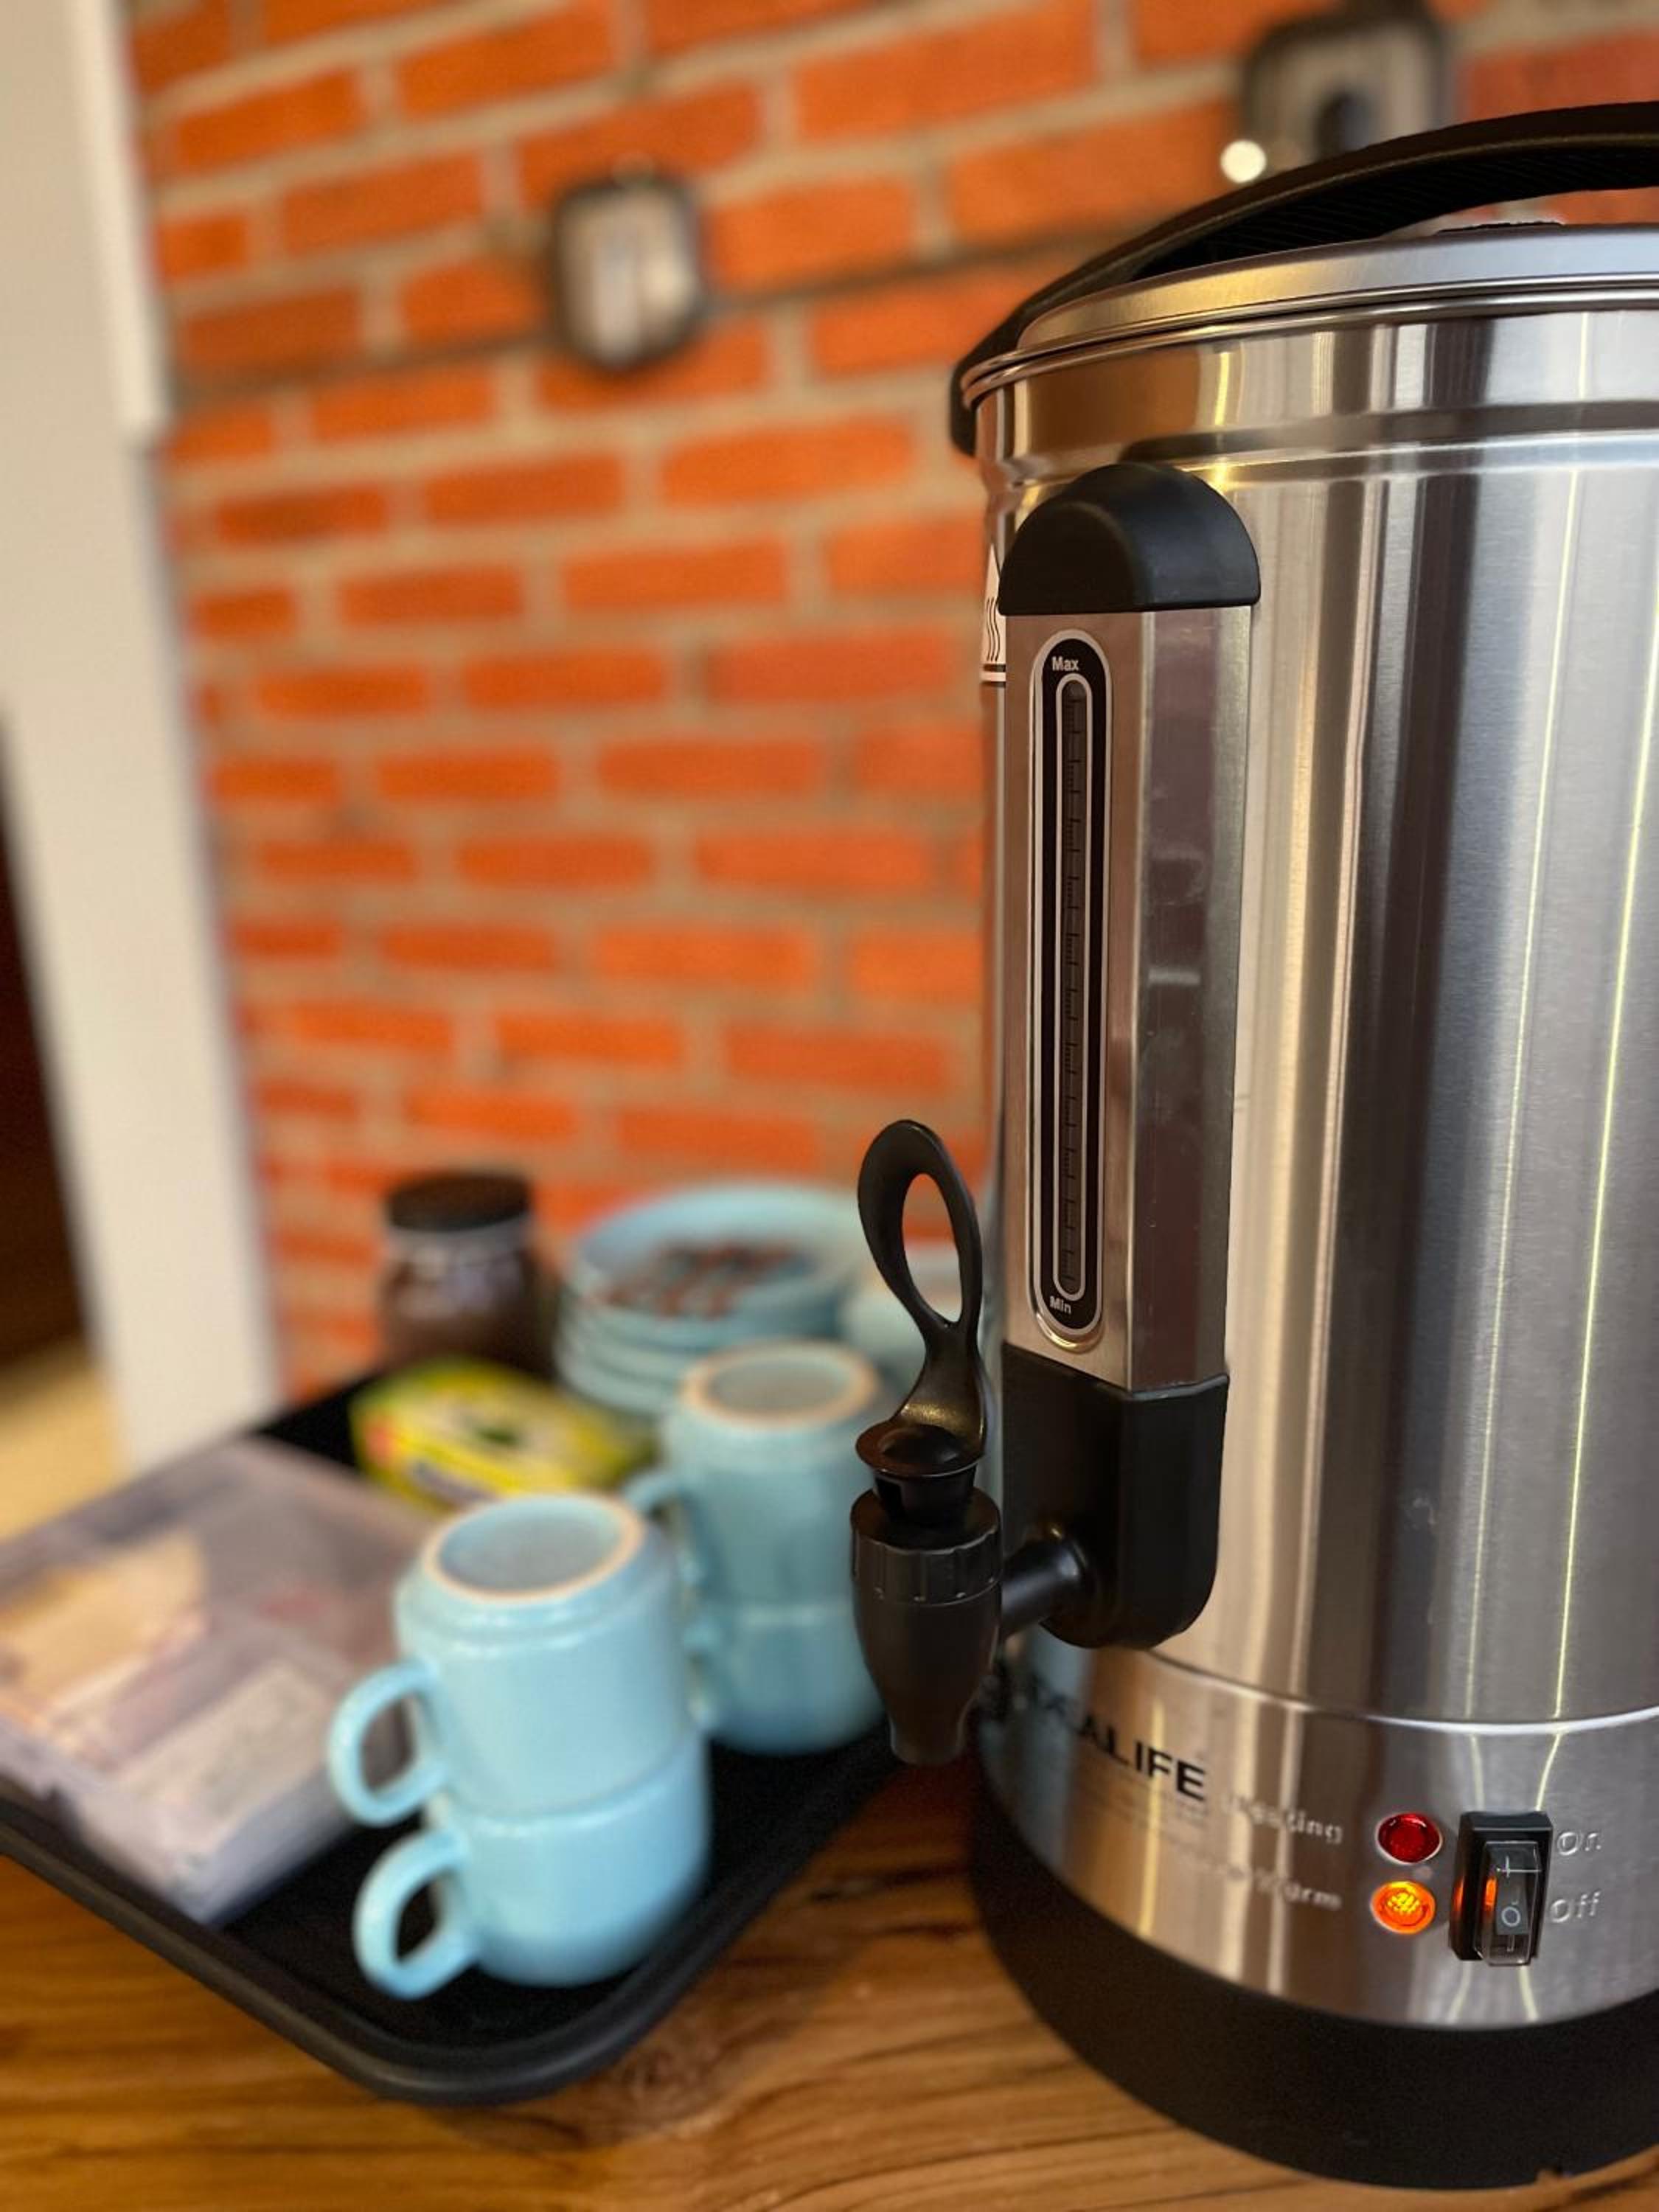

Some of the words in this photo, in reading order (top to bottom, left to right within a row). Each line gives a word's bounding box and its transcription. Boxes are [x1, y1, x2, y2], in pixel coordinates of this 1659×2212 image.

[1052, 656, 1079, 671] Max
[1049, 1295, 1071, 1314] Min
[1557, 1831, 1601, 1857] On
[1549, 1891, 1602, 1924] Off
